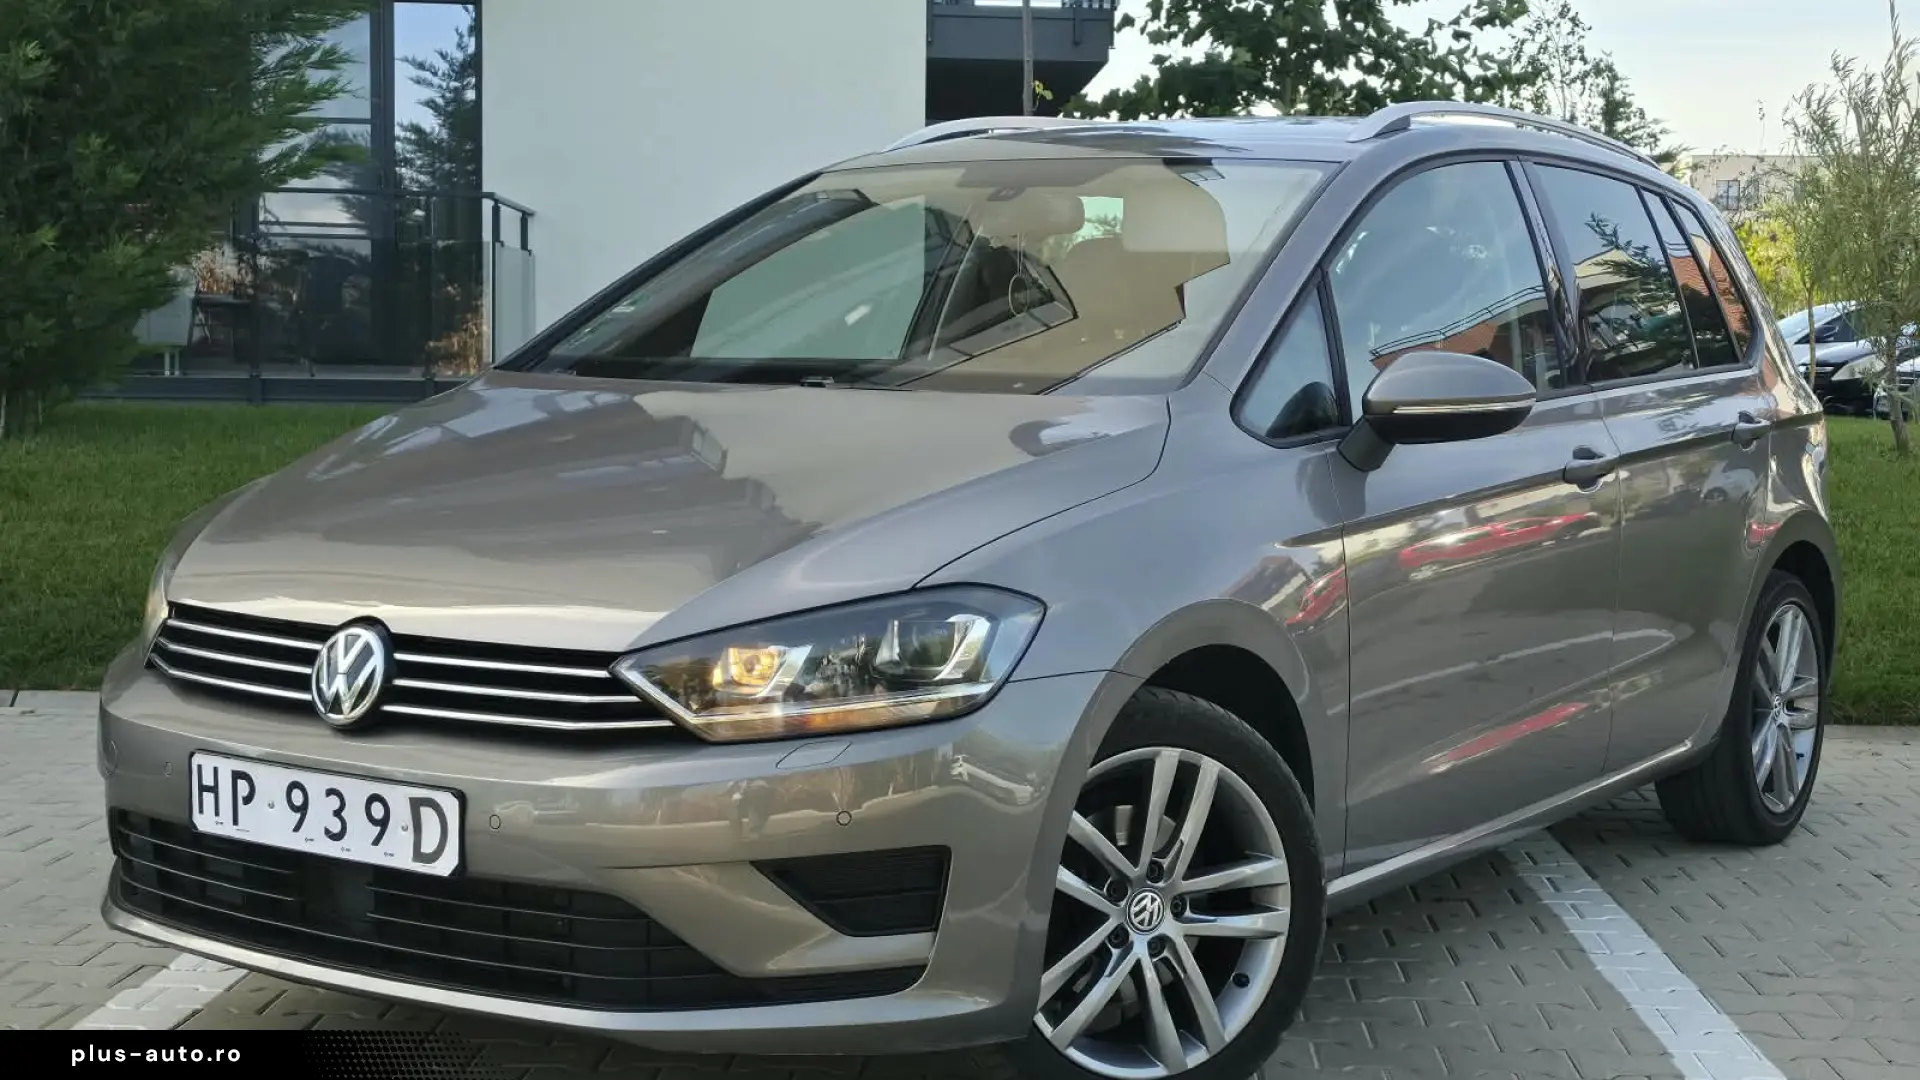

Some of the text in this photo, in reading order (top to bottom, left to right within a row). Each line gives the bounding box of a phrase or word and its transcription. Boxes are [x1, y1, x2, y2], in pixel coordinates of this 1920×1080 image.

[312, 627, 384, 725] VW
[197, 763, 449, 865] HP 939 D
